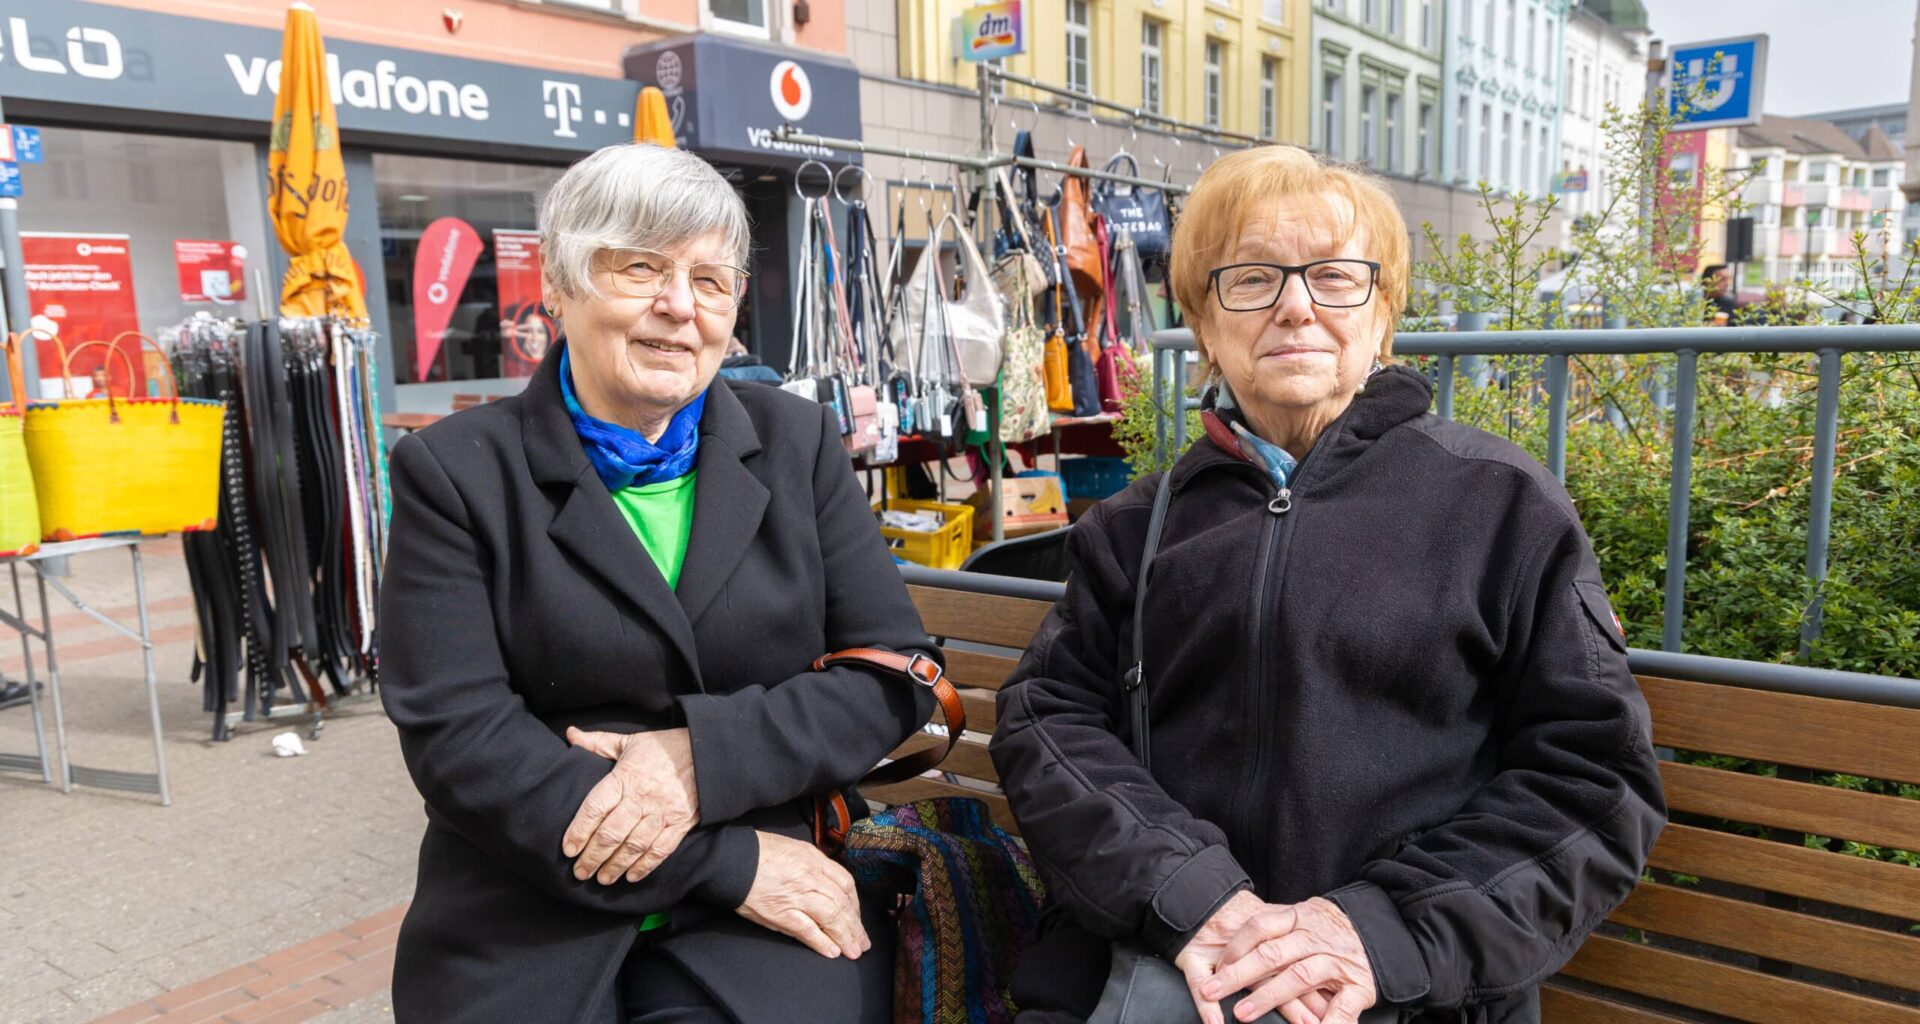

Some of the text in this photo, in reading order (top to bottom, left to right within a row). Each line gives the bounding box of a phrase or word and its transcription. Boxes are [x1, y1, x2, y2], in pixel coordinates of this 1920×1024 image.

[979, 12, 1009, 37] dm
[1686, 54, 1738, 112] U
[1120, 207, 1145, 219] THE
